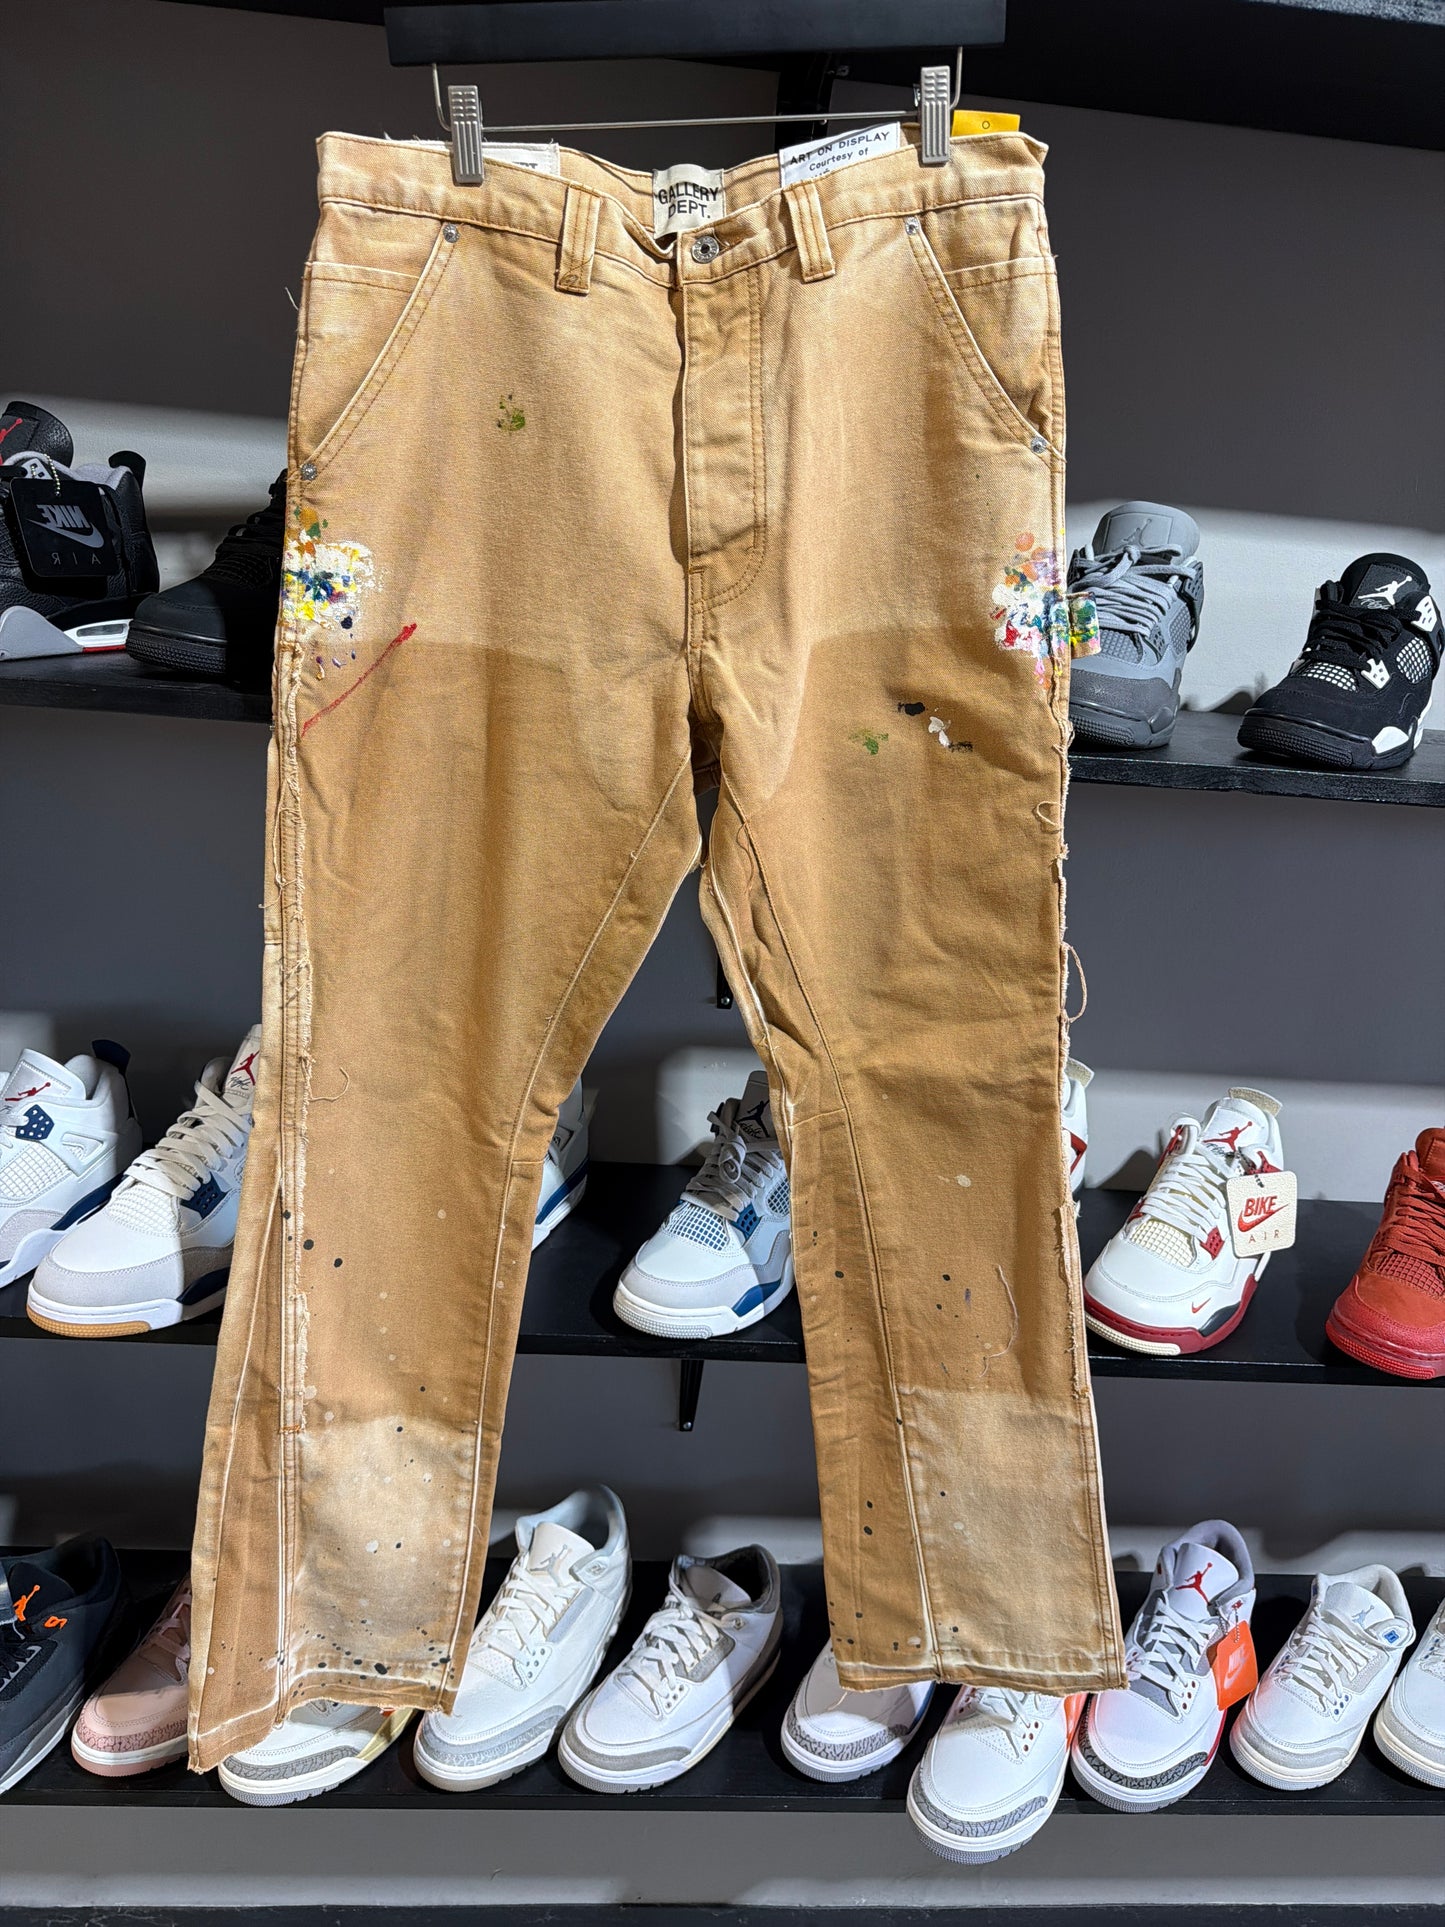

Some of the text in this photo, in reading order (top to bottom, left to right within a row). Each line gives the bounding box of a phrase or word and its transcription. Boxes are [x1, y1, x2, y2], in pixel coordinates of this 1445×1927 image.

[790, 131, 890, 165] ART ON DISPLAY
[808, 146, 869, 171] Courtesy of
[658, 181, 719, 205] GALLERY
[668, 199, 711, 219] DEPT.
[1243, 1195, 1278, 1217] BIKE
[1248, 1229, 1280, 1244] AIR
